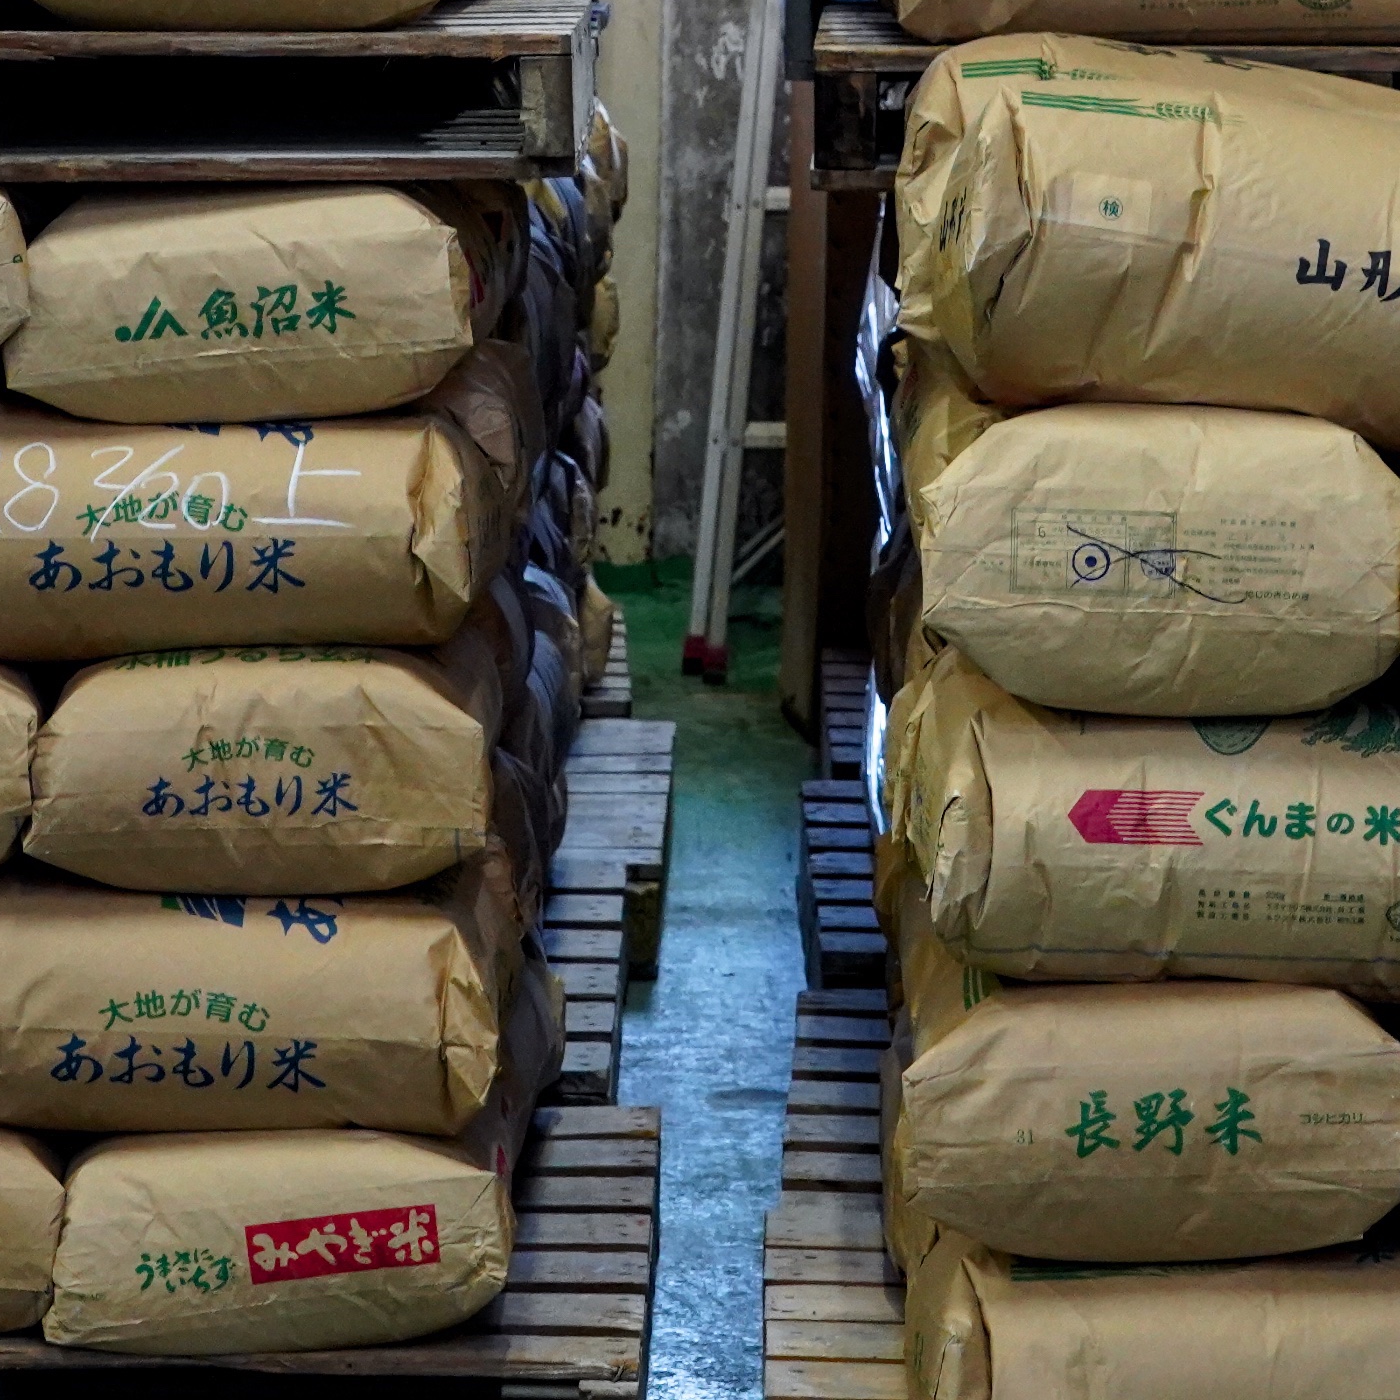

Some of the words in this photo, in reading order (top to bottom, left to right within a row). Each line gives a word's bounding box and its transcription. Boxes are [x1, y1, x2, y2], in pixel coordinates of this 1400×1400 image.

[1098, 195, 1124, 221] 検
[200, 281, 356, 339] 魚沼米
[251, 440, 363, 529] 上
[76, 494, 248, 536] 大地が育む
[29, 539, 306, 594] あおもり米
[181, 738, 314, 770] 大地が育む
[142, 773, 359, 819] あおもり米
[98, 989, 271, 1033] 大地が育む
[50, 1034, 327, 1094] あおもり米
[1065, 1088, 1263, 1159] 長野米
[1299, 1111, 1365, 1126] コシヒカリ
[252, 1208, 437, 1267] みやぎ米
